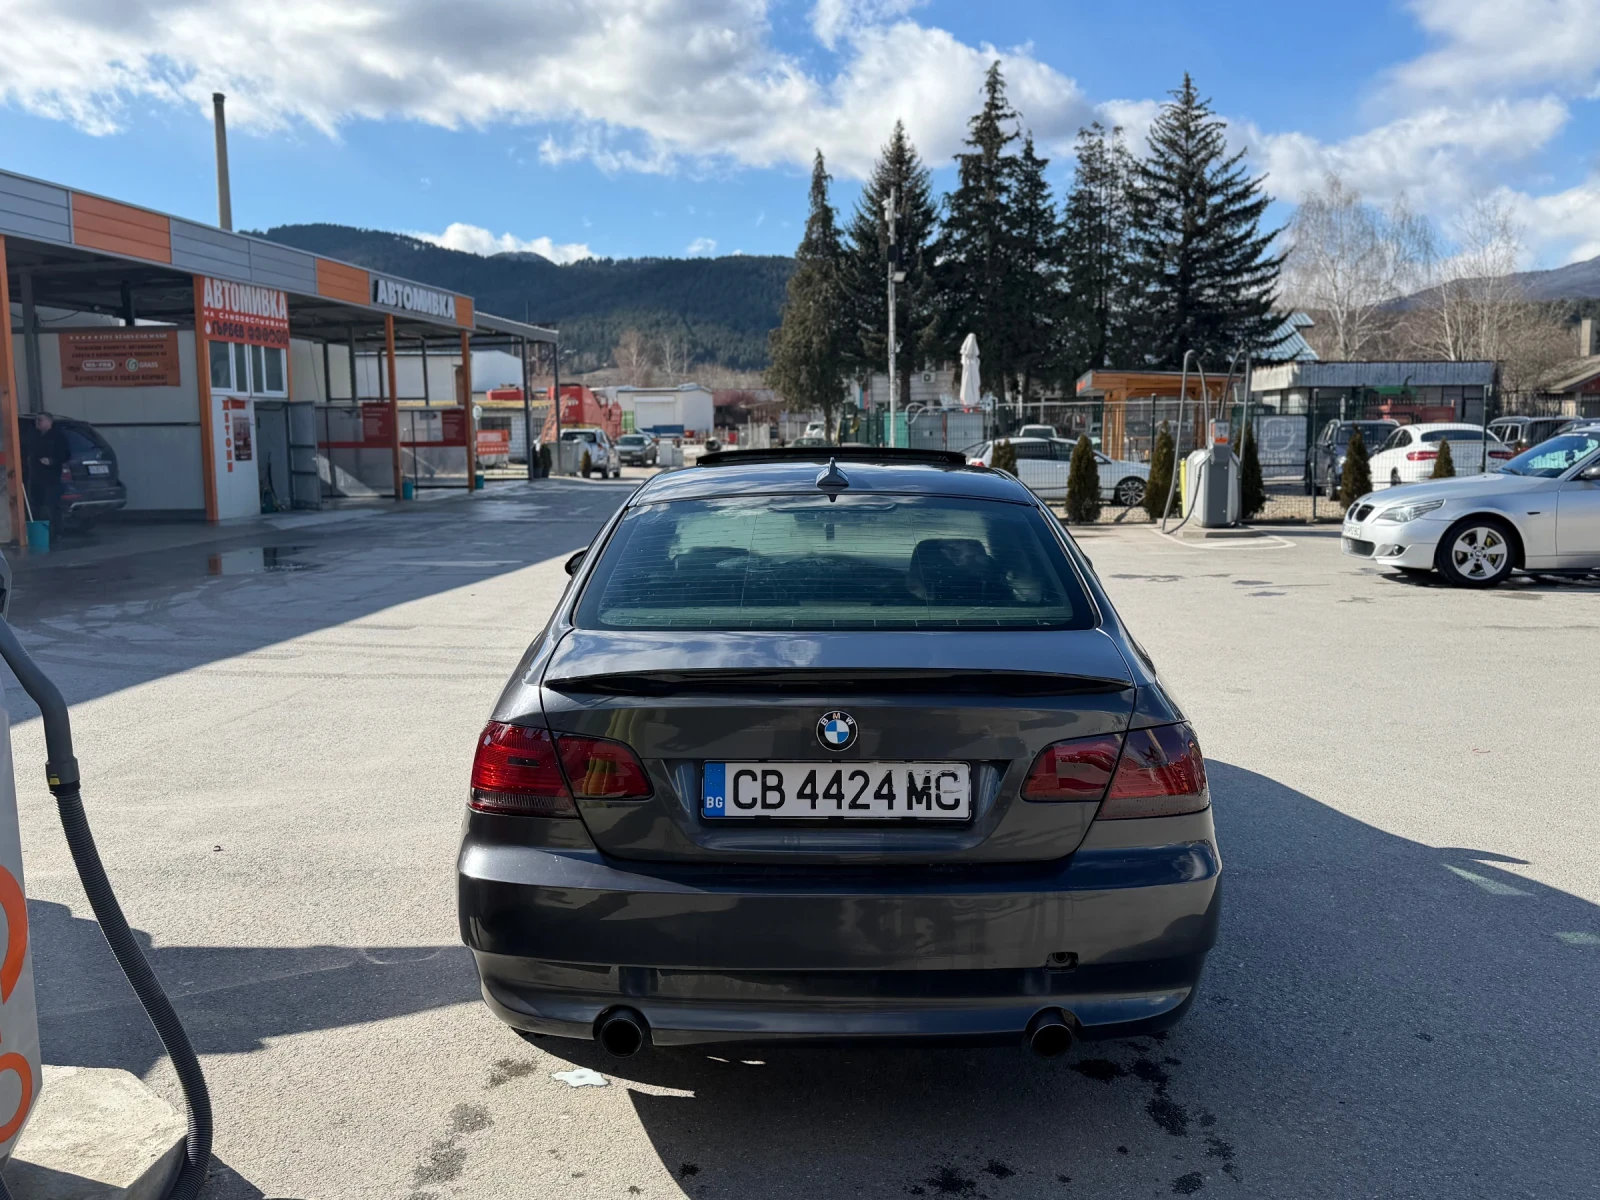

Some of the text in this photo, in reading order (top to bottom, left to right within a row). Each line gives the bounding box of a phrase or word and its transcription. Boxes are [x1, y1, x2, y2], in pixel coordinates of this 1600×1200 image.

[203, 277, 288, 320] АВТОМИВКА
[203, 310, 215, 318] НА
[377, 279, 456, 319] АВТОМИВКА
[820, 712, 854, 726] BMW
[706, 769, 961, 811] BG CB 4424 MC
